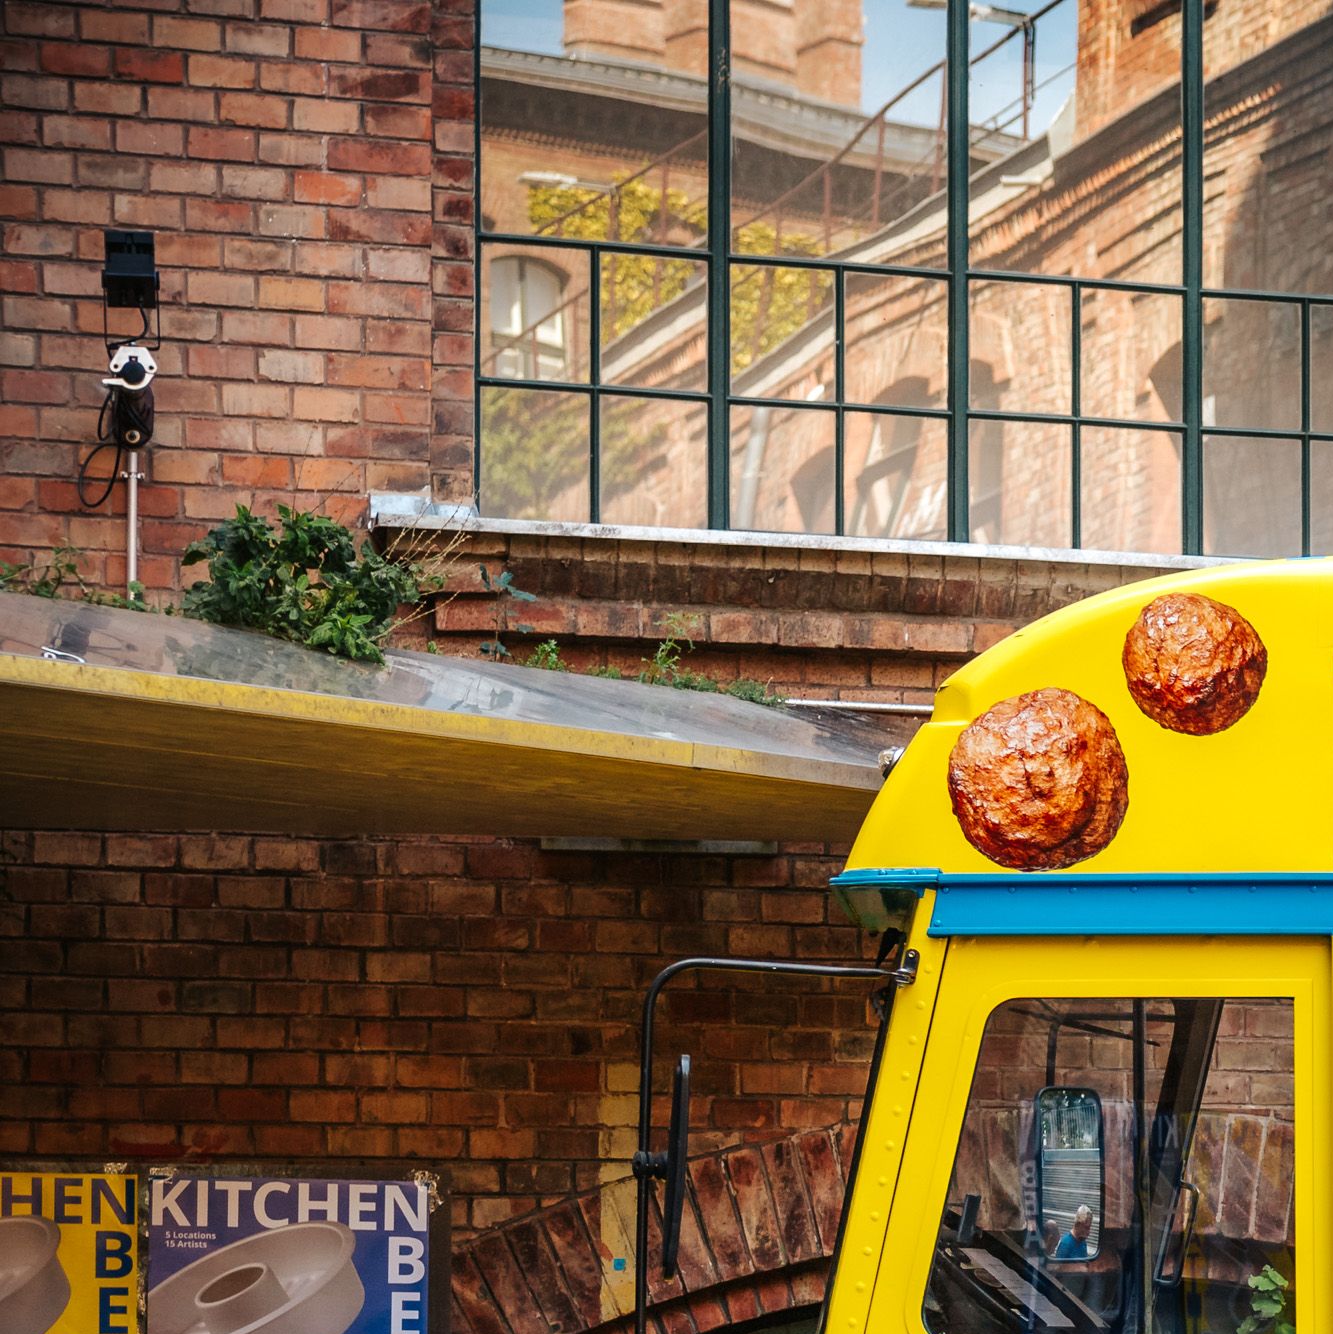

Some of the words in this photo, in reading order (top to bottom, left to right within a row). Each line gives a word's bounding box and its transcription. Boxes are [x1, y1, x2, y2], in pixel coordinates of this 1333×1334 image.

[151, 1179, 428, 1232] KITCHEN
[165, 1231, 171, 1239] 5
[173, 1231, 217, 1240] Locations
[165, 1239, 176, 1248] 15
[177, 1240, 208, 1249] Artists
